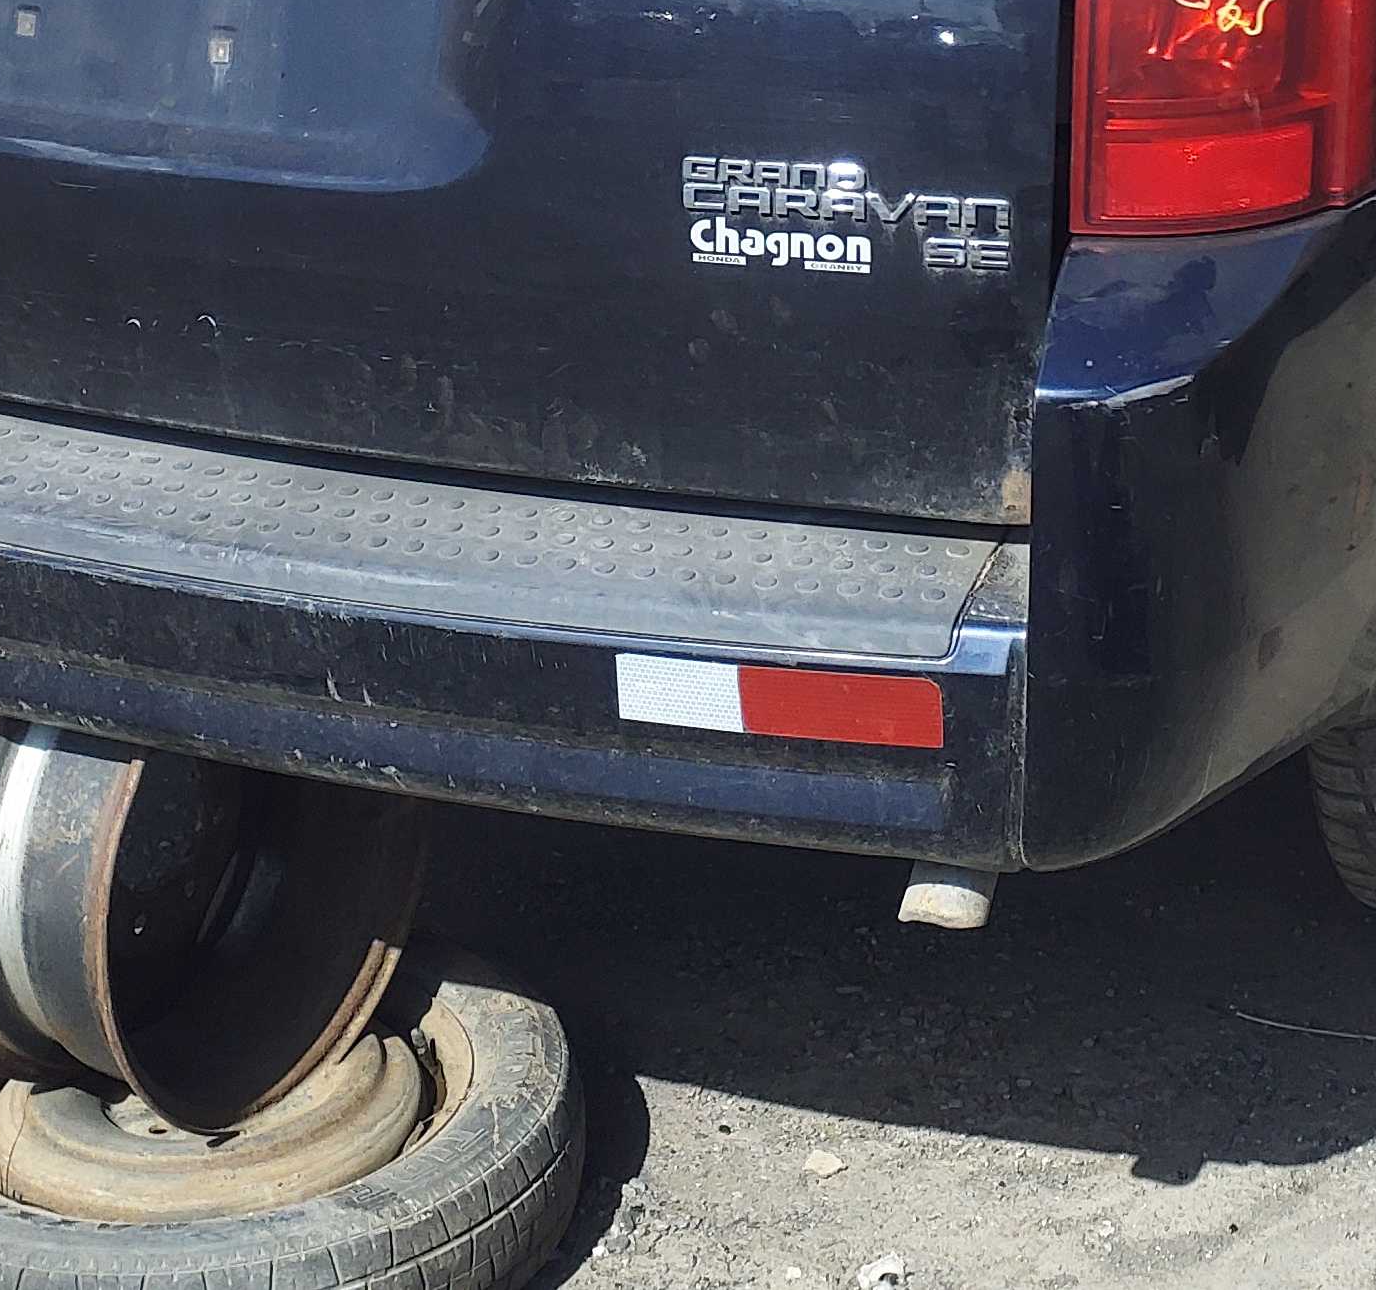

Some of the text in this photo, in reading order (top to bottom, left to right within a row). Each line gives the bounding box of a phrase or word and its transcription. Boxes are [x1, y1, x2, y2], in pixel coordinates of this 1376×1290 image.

[682, 155, 867, 190] GRAND
[682, 182, 1012, 228] CARAVAN
[689, 216, 872, 267] Chagnon
[698, 254, 741, 264] HONDA
[925, 236, 1011, 271] SE
